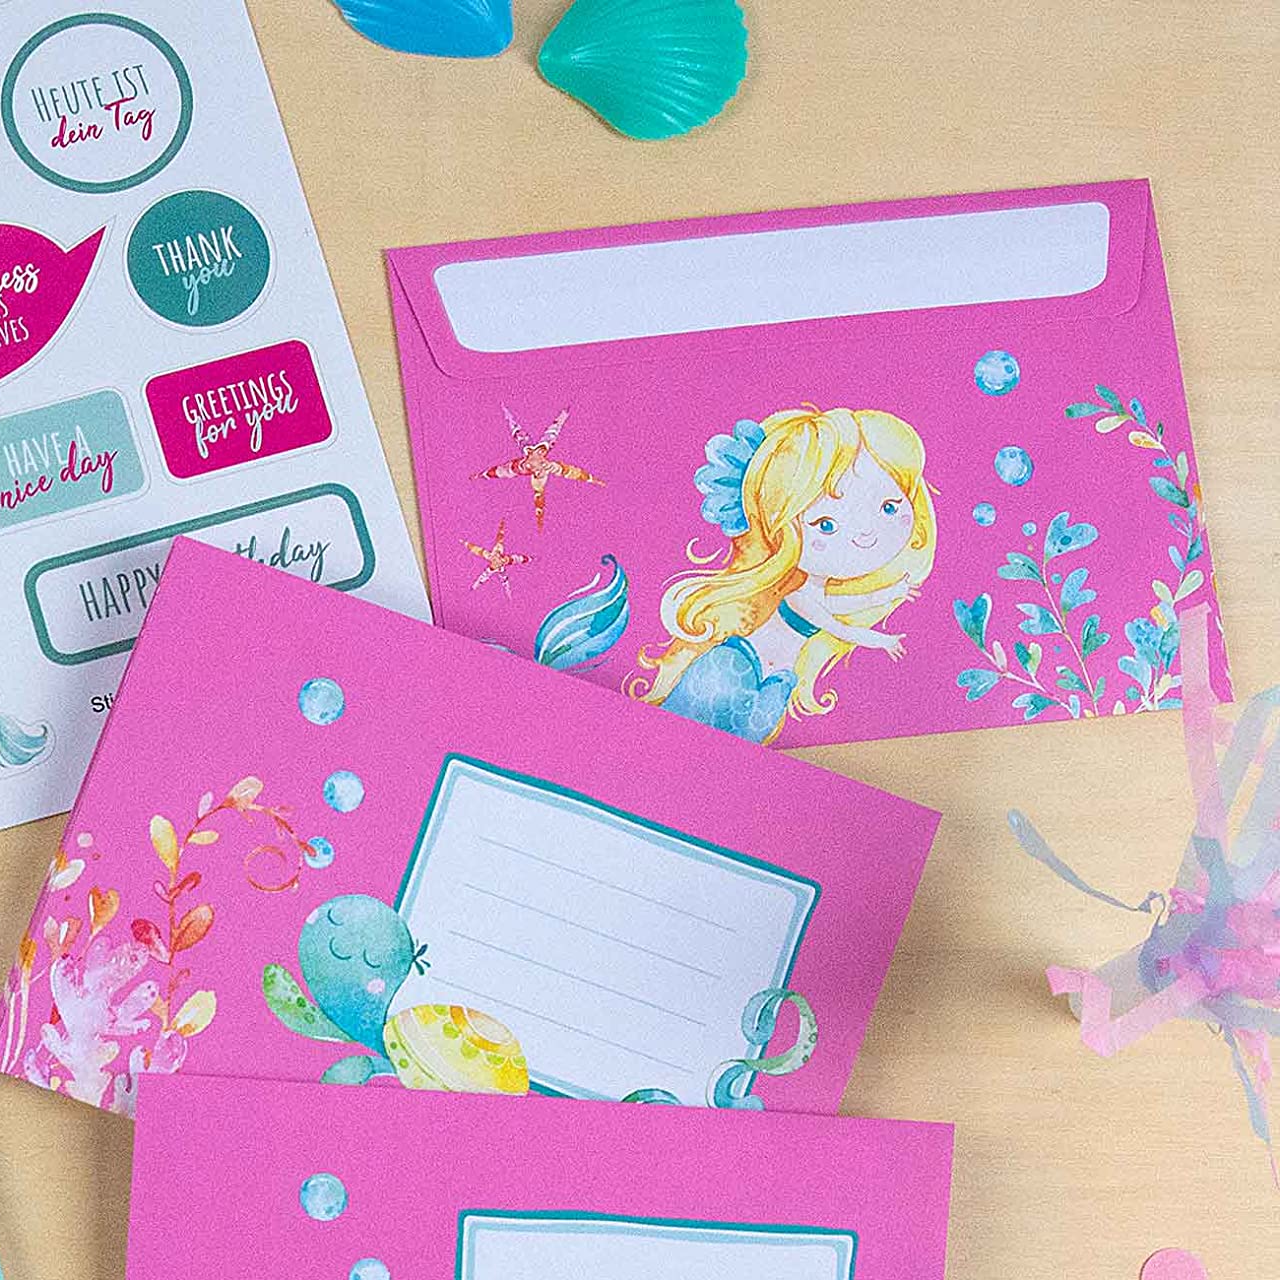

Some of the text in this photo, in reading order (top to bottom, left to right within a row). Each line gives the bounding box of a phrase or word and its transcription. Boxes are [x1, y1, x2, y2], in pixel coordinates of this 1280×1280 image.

[31, 64, 150, 123] HEUTE IST
[50, 95, 157, 149] dein Tag
[151, 225, 243, 277] THANK
[182, 257, 236, 316] you
[181, 369, 293, 425] GREETINGS
[2, 430, 68, 479] HAVE
[195, 393, 299, 460] for you
[0, 439, 119, 510] nice day
